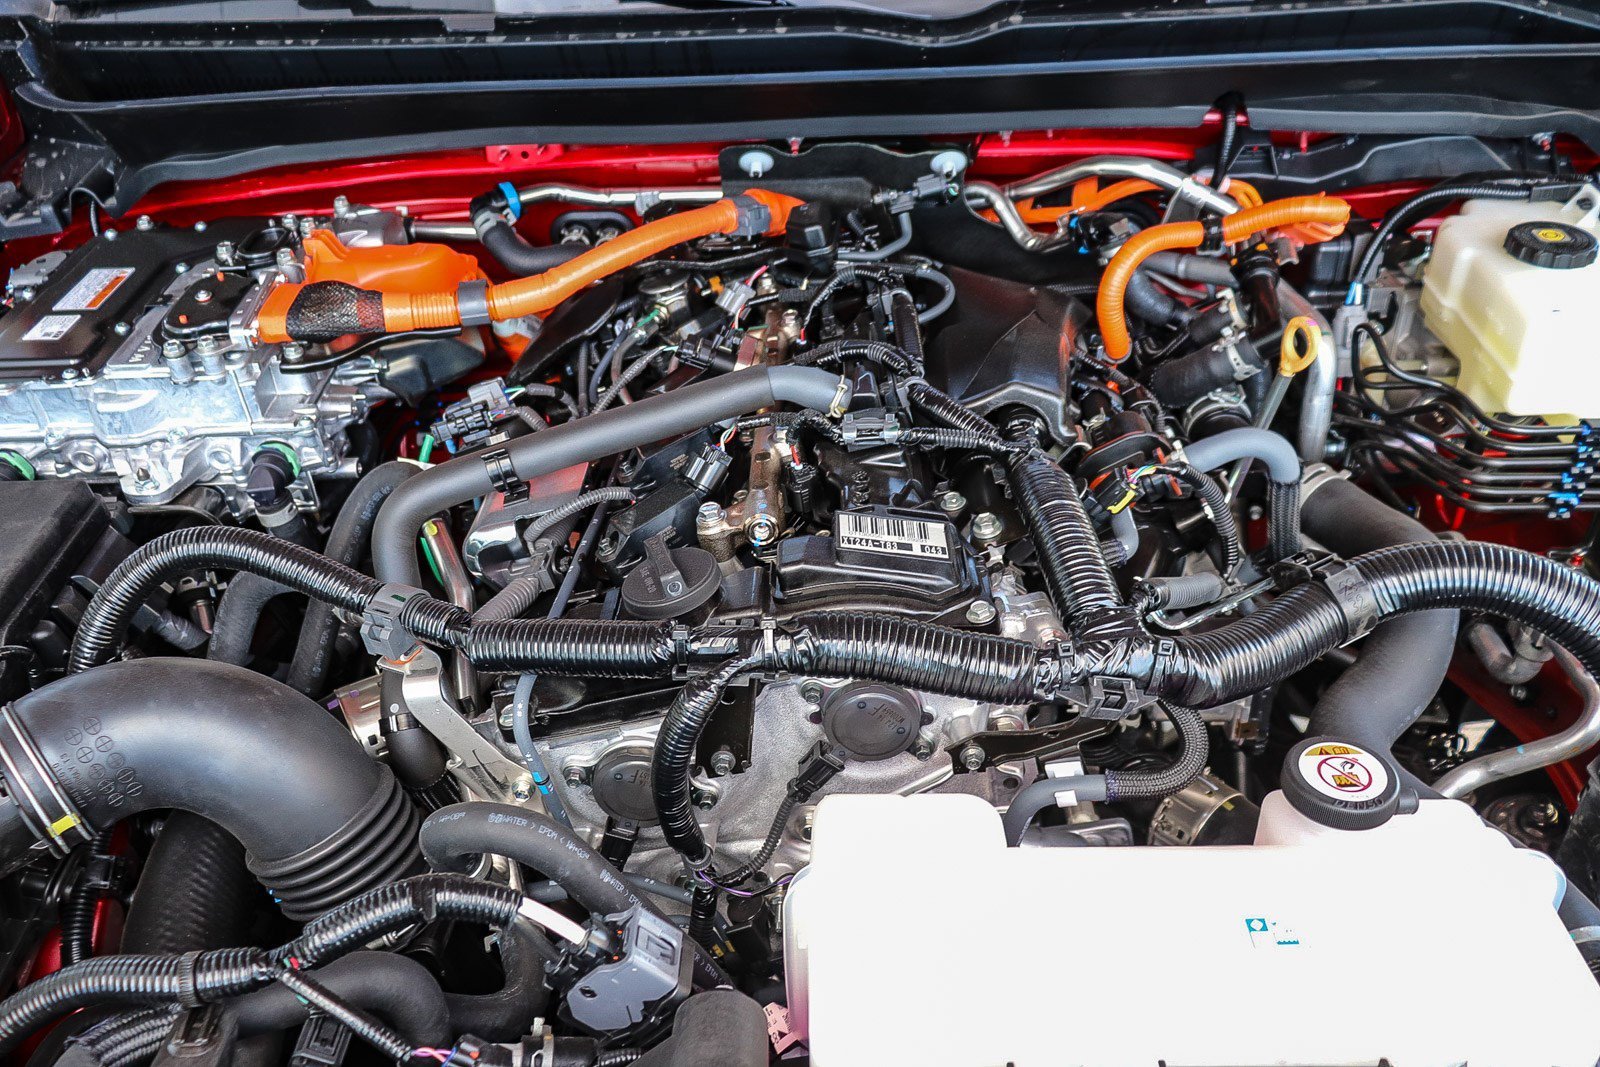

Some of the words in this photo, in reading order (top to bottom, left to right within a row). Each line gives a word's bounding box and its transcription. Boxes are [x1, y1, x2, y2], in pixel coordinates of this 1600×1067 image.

[924, 545, 943, 555] 043
[1333, 798, 1385, 811] DENSO
[538, 825, 559, 840] EPDM
